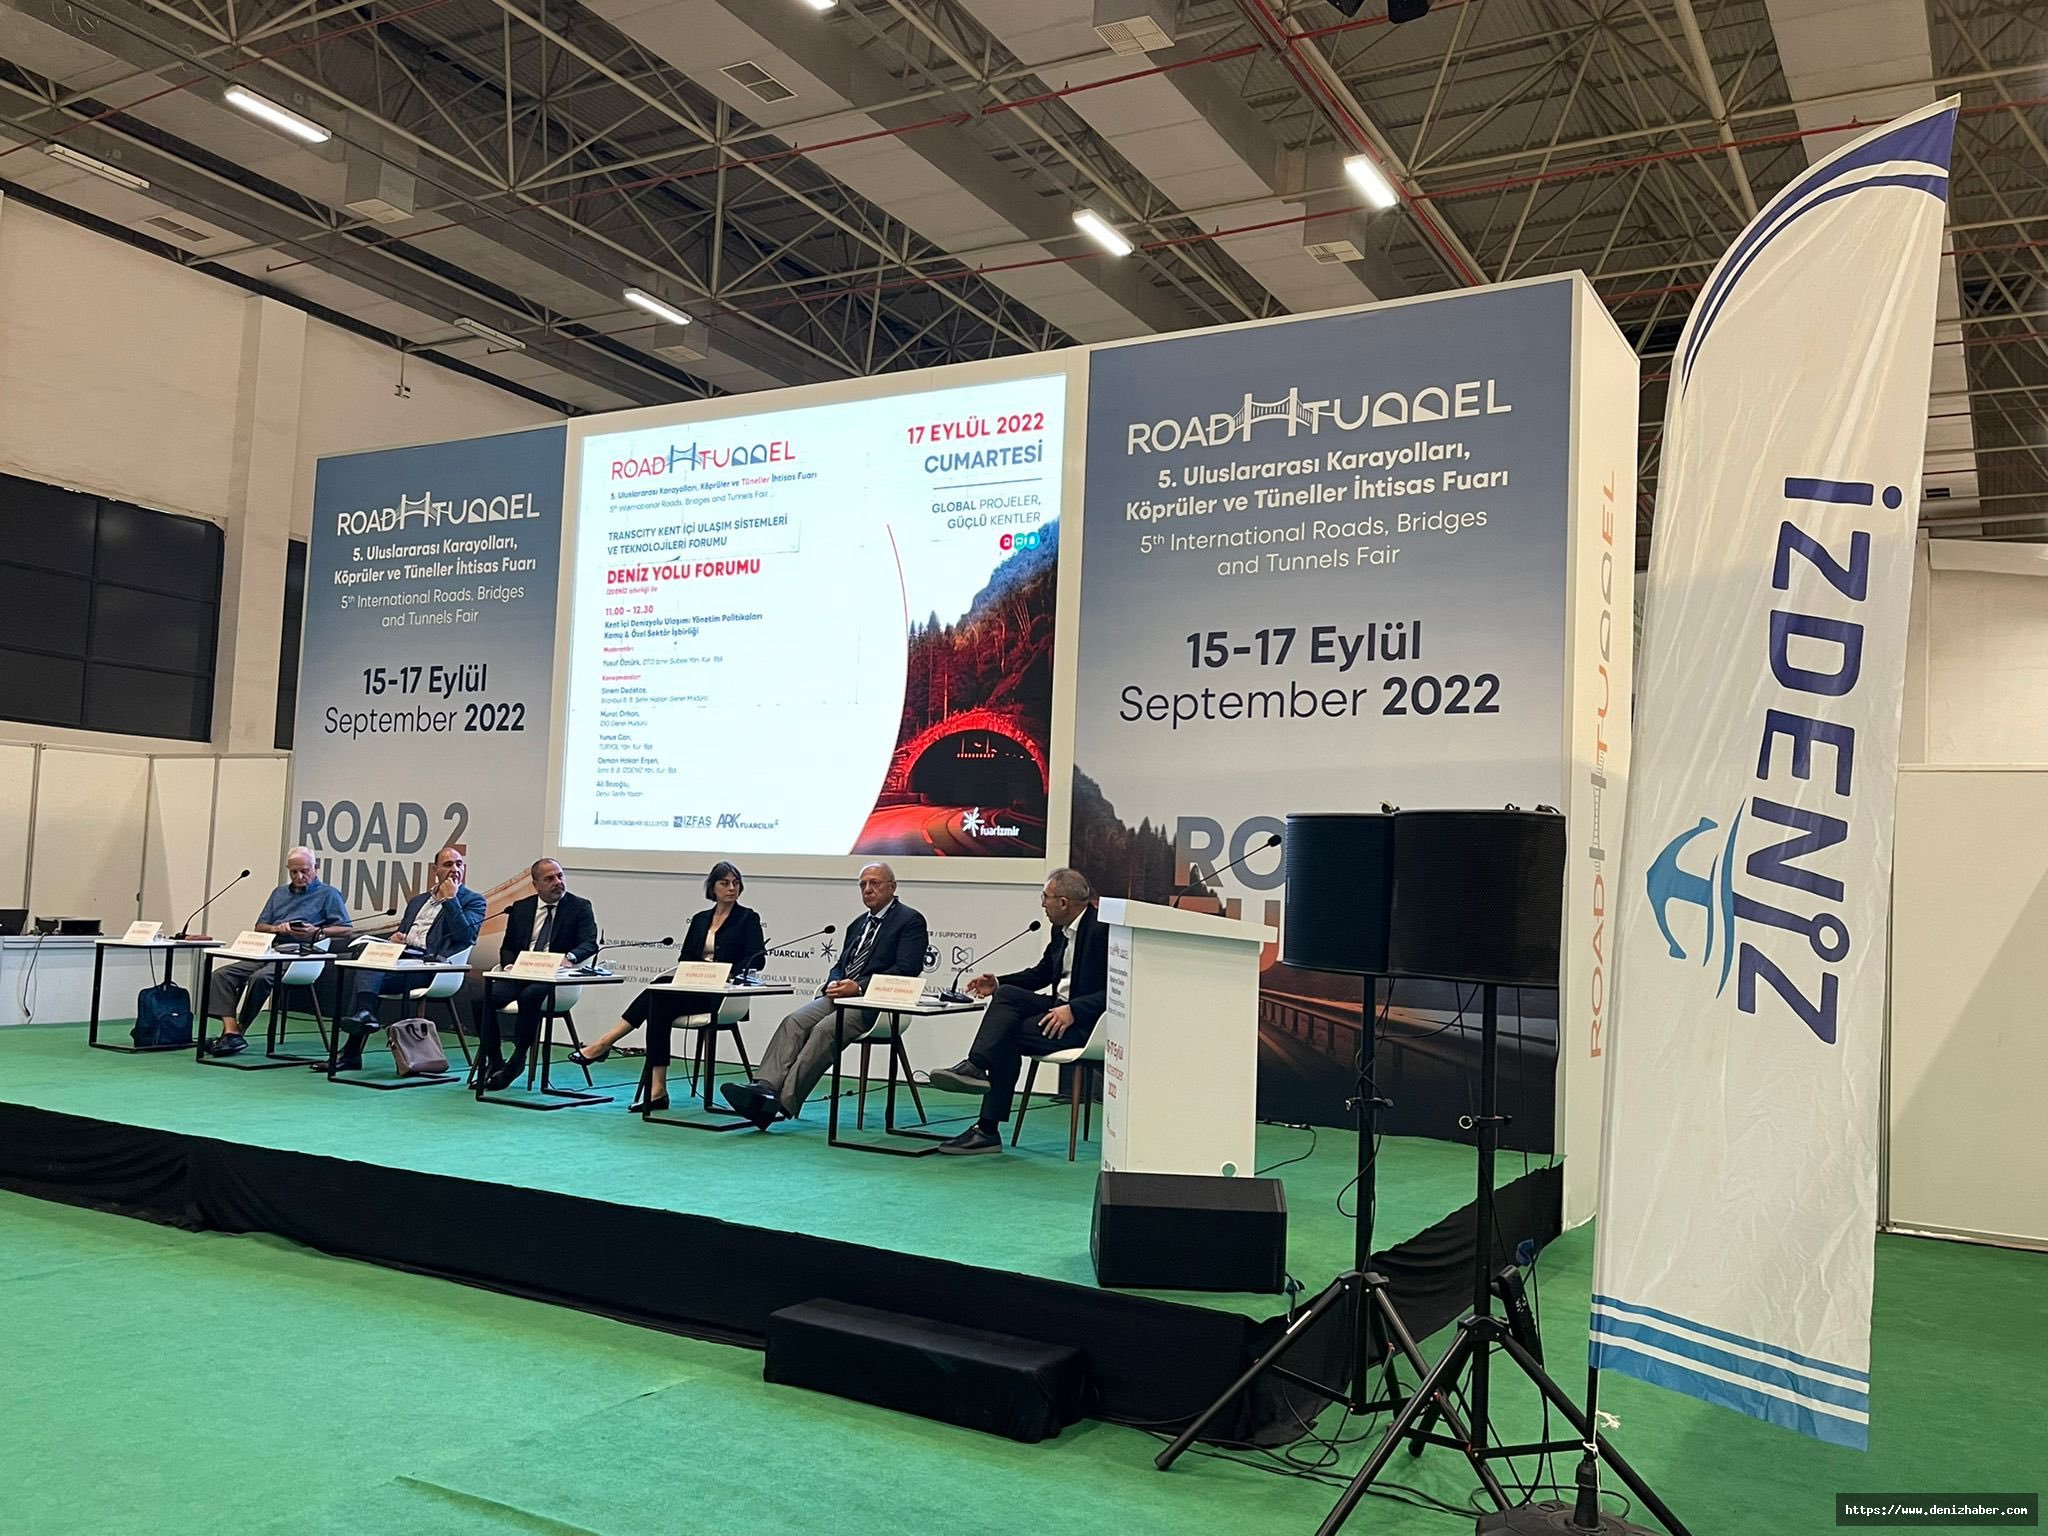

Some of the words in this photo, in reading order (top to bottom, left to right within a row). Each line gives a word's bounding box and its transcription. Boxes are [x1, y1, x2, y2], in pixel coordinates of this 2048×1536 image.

[907, 426, 925, 444] 17
[930, 416, 990, 442] EYLÜL
[996, 412, 1044, 434] 2022
[924, 440, 1042, 473] CUMARTESİ
[1158, 470, 1177, 488] 5.
[1184, 458, 1320, 486] Uluslararası
[1327, 442, 1471, 472] Karayolları,
[618, 488, 658, 500] Uluslararası
[700, 480, 730, 492] Köprüler
[742, 476, 770, 486] Tüneller
[772, 472, 796, 482] İhtisas
[712, 494, 726, 503] and
[1126, 497, 1216, 523] Köprüler
[1223, 496, 1248, 512] ve
[1254, 484, 1348, 509] Tüneller
[1354, 474, 1436, 500] İhtisas
[1443, 470, 1510, 492] Fuarı
[932, 500, 976, 514] GLOBAL
[979, 495, 1041, 510] PROJELER,
[608, 527, 656, 541] TRANSCITY
[658, 525, 680, 536] KENT
[683, 522, 695, 535] İÇİ
[697, 520, 732, 534] ULAŞIM
[734, 512, 788, 528] SİSTEMLERİ
[948, 514, 987, 530] GÜÇLÜ
[990, 512, 1041, 526] KENTLER
[1140, 534, 1165, 554] 5th
[1170, 522, 1306, 550] International
[1313, 518, 1389, 540] Roads,
[1398, 509, 1488, 536] Bridges
[353, 548, 364, 562] 5.
[367, 542, 440, 560] Uluslararası
[443, 535, 518, 554] Karayolları,
[608, 546, 618, 555] VE
[620, 538, 687, 554] TEKNOLOJİLERİ
[689, 536, 727, 548] FORUMU
[334, 566, 384, 586] Köprüler
[388, 568, 401, 580] ve
[404, 562, 452, 580] Tüneller
[456, 558, 498, 575] İhtisas
[502, 557, 536, 571] Fuarı
[607, 563, 648, 584] DENİZ
[652, 564, 690, 580] YOLU
[695, 559, 760, 578] FORUMU
[1217, 556, 1260, 576] and
[1266, 548, 1349, 572] Tunnels
[1357, 546, 1400, 565] Fair
[341, 594, 355, 609] 5th
[357, 591, 430, 608] International
[478, 585, 524, 602] Bridges
[605, 607, 624, 616] 11.00
[633, 605, 654, 614] 12.30
[382, 614, 404, 627] and
[409, 611, 452, 625] Tunnels
[456, 610, 479, 623] Fair
[692, 615, 720, 624] Yönetim
[1186, 628, 1296, 668] 15-17
[1310, 620, 1421, 672] Eylül
[363, 666, 422, 694] 15-17
[429, 664, 487, 699] Eylül
[1120, 681, 1368, 730] September
[1382, 673, 1500, 716] 2022
[325, 705, 457, 740] September
[464, 703, 525, 732] 2022
[1733, 476, 1902, 1044] İZDENİZ
[299, 800, 428, 856] ROAD
[444, 802, 469, 856] 2
[980, 825, 1020, 836] fuarizmir
[770, 950, 810, 959] FUARCILIK
